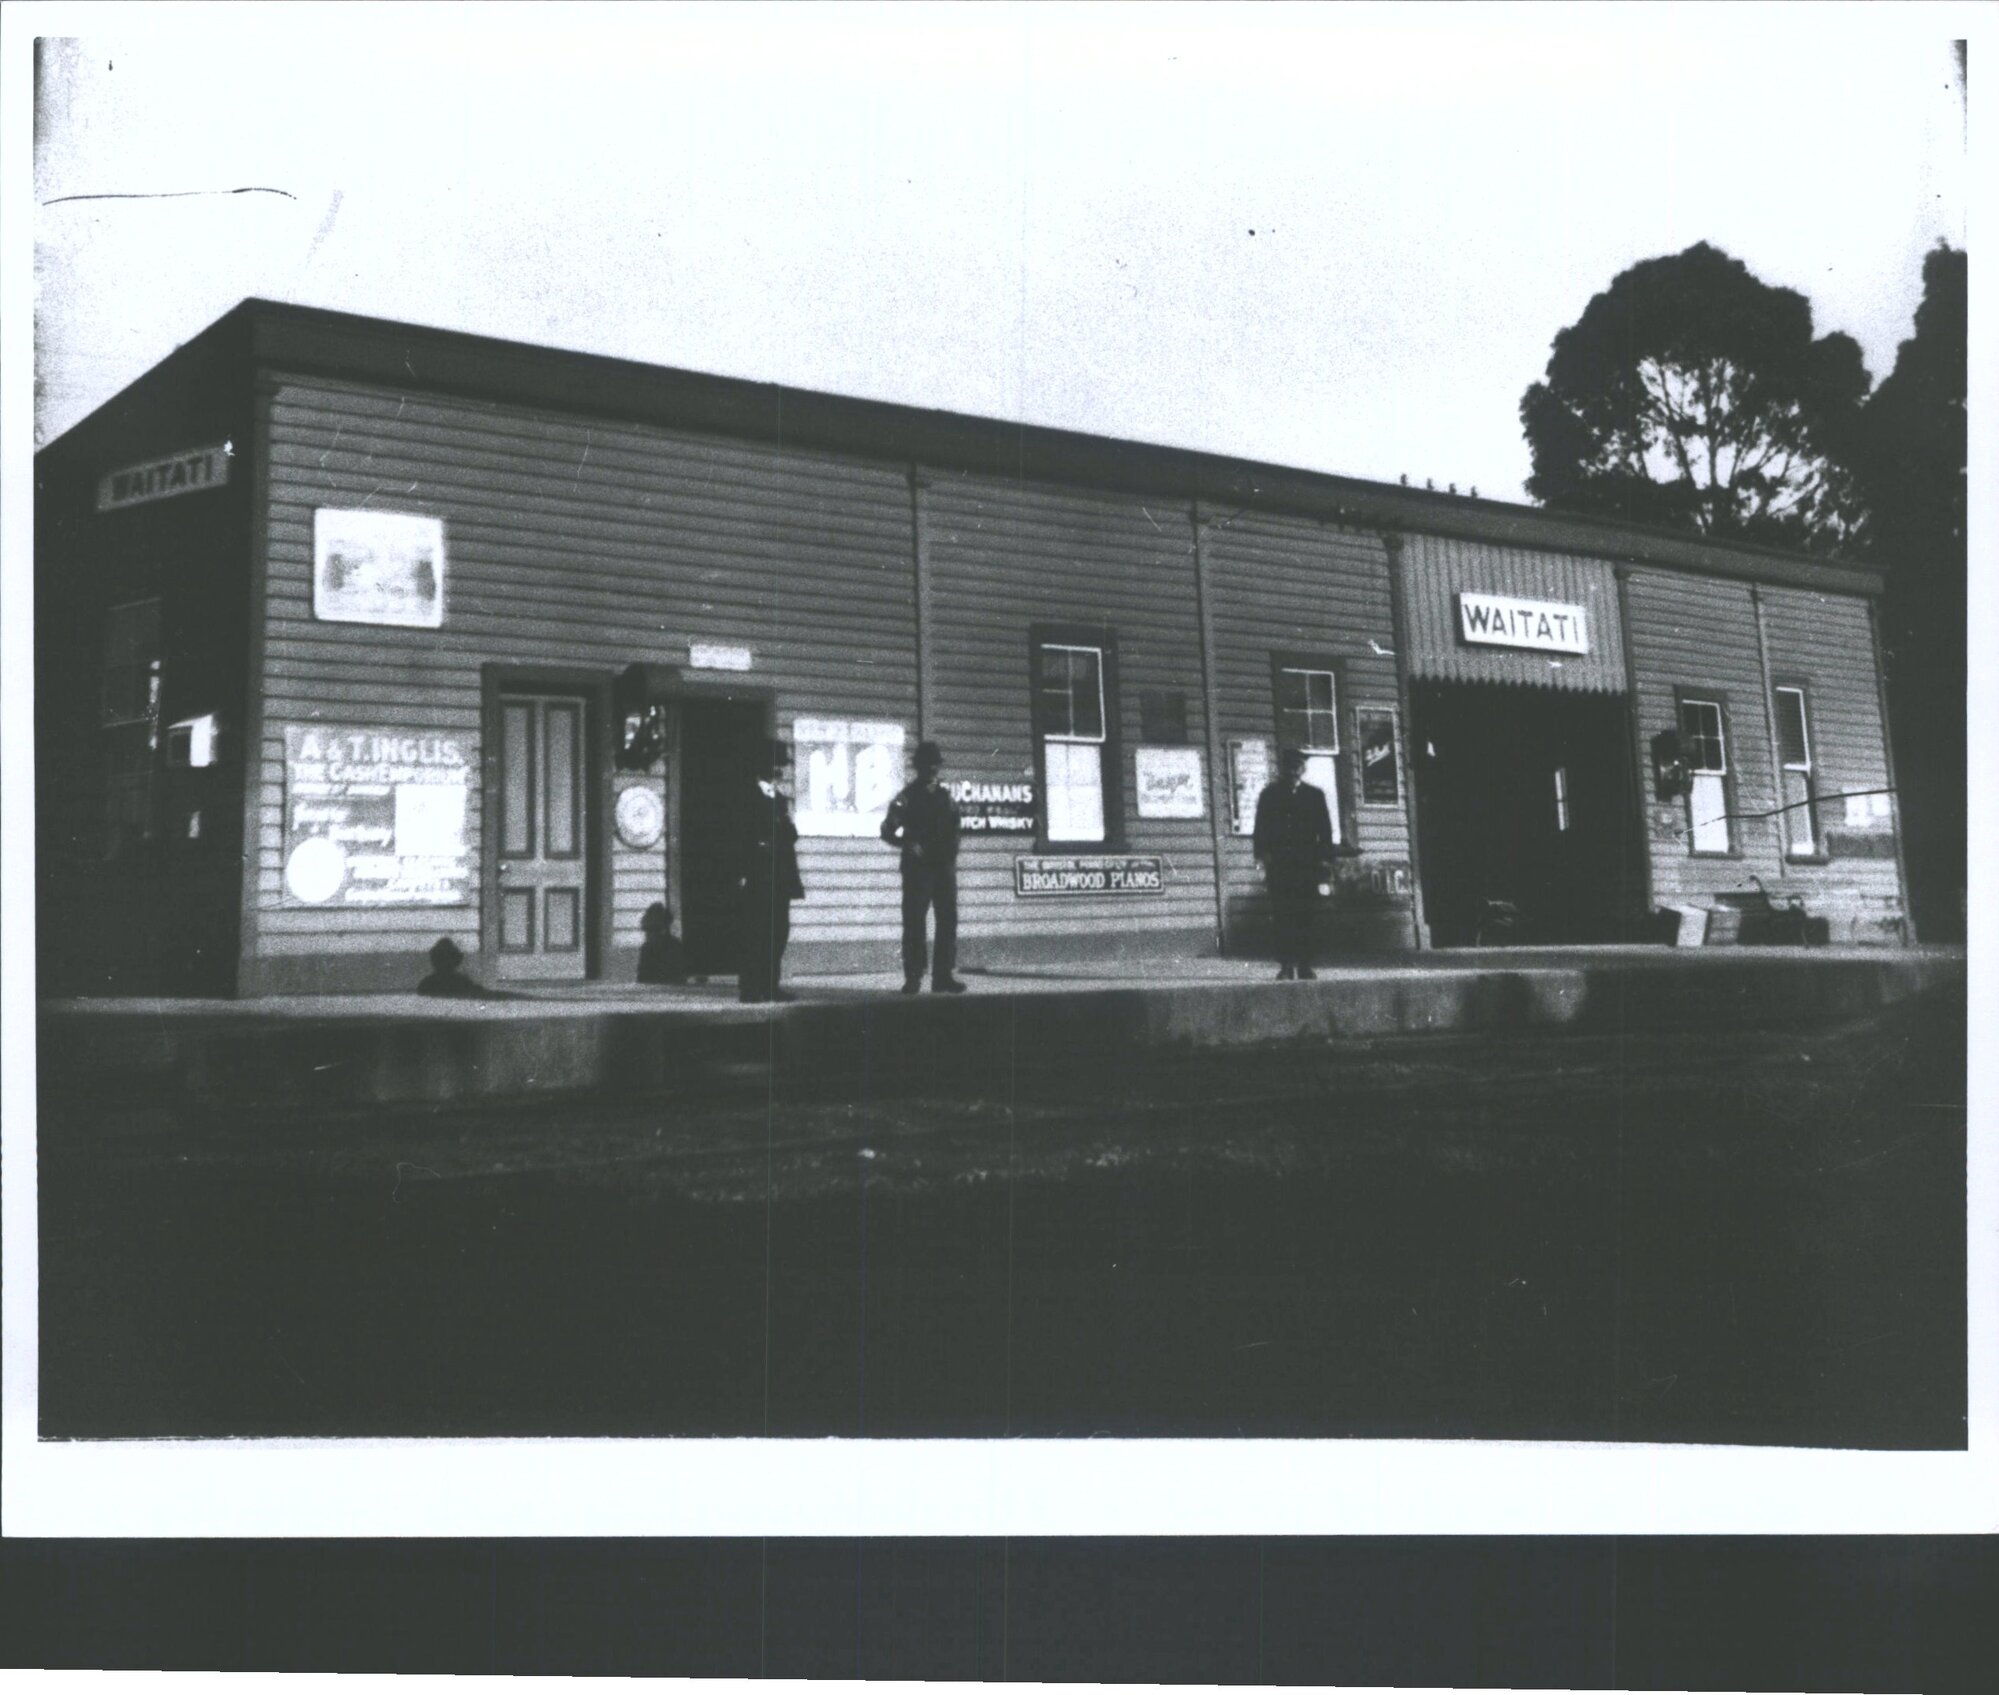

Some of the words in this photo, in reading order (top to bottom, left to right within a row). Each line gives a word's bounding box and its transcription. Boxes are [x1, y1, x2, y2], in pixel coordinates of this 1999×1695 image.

[112, 453, 213, 502] WAITATI
[1464, 603, 1579, 643] WAITATI
[299, 734, 321, 760] A
[987, 815, 1034, 830] WHISKY
[1022, 871, 1106, 890] BROADWOOD
[1110, 871, 1160, 888] PIANOS
